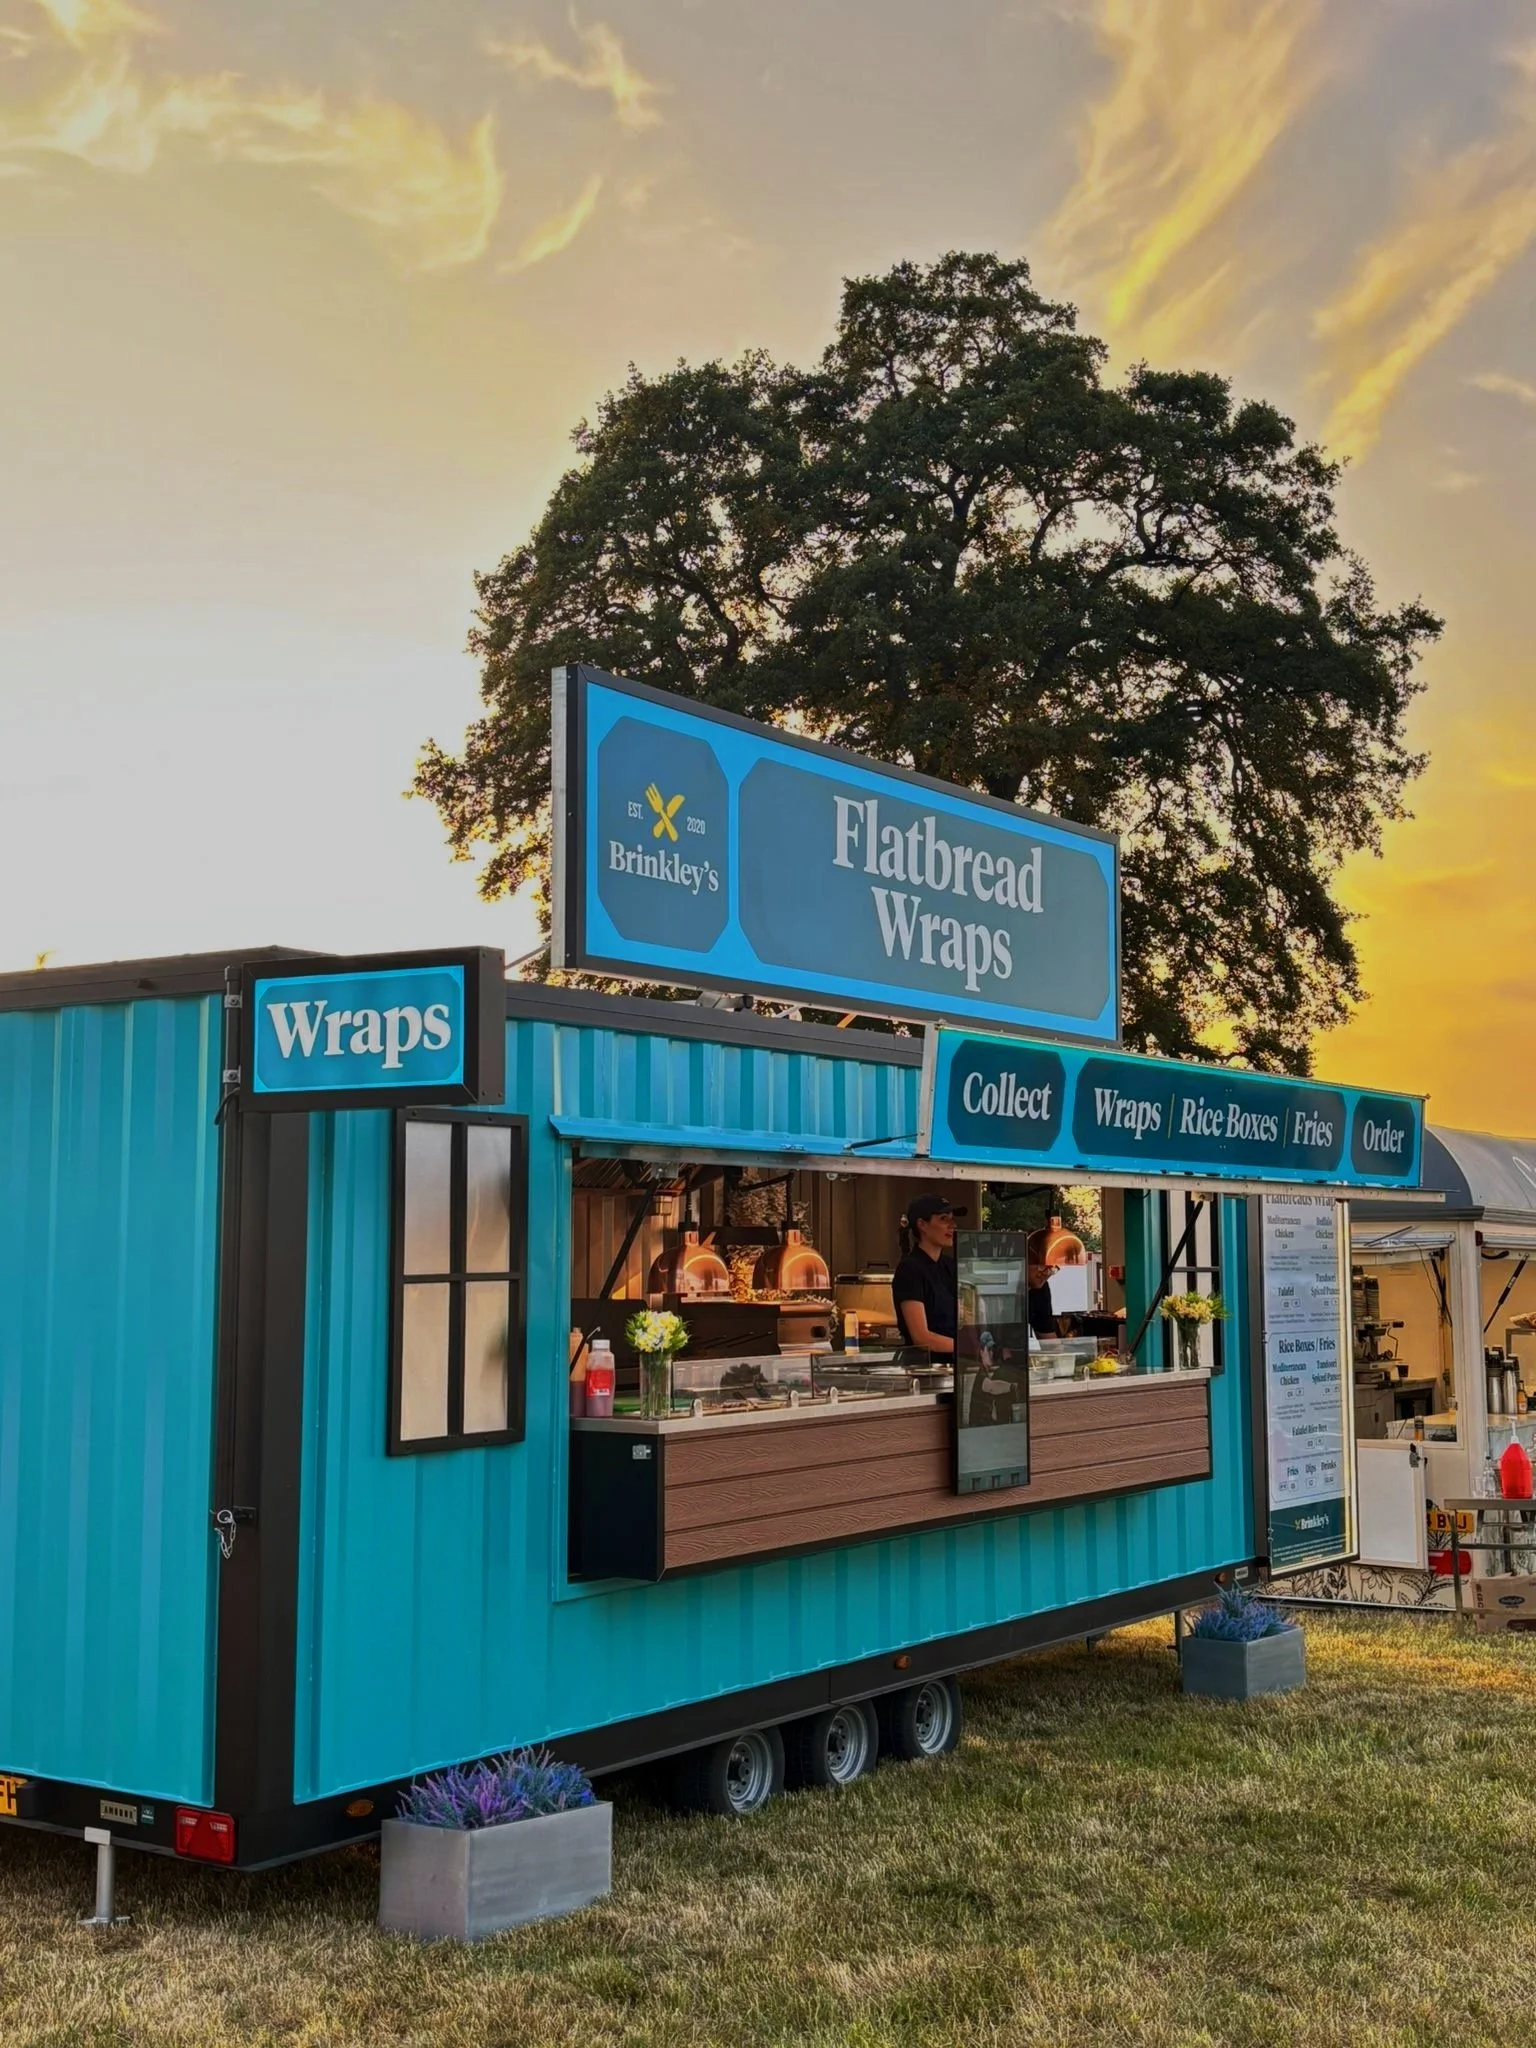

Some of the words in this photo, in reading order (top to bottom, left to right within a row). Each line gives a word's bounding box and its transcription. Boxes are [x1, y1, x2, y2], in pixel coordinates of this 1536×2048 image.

[628, 801, 643, 820] EST.
[686, 816, 706, 835] 2020
[608, 840, 719, 896] Brinkley's
[833, 795, 1044, 914] Flatbread
[871, 885, 1013, 992] Wraps
[266, 1000, 452, 1069] Wraps
[963, 1071, 1051, 1121] Collect
[1094, 1087, 1162, 1140] Wraps
[1179, 1097, 1223, 1138] Rice
[1225, 1098, 1279, 1142] Boxes
[1292, 1110, 1333, 1148] Fries
[1363, 1119, 1405, 1154] Order
[1278, 1339, 1294, 1353] Rice
[1295, 1339, 1315, 1352] Boxes
[1319, 1336, 1336, 1351] Fries
